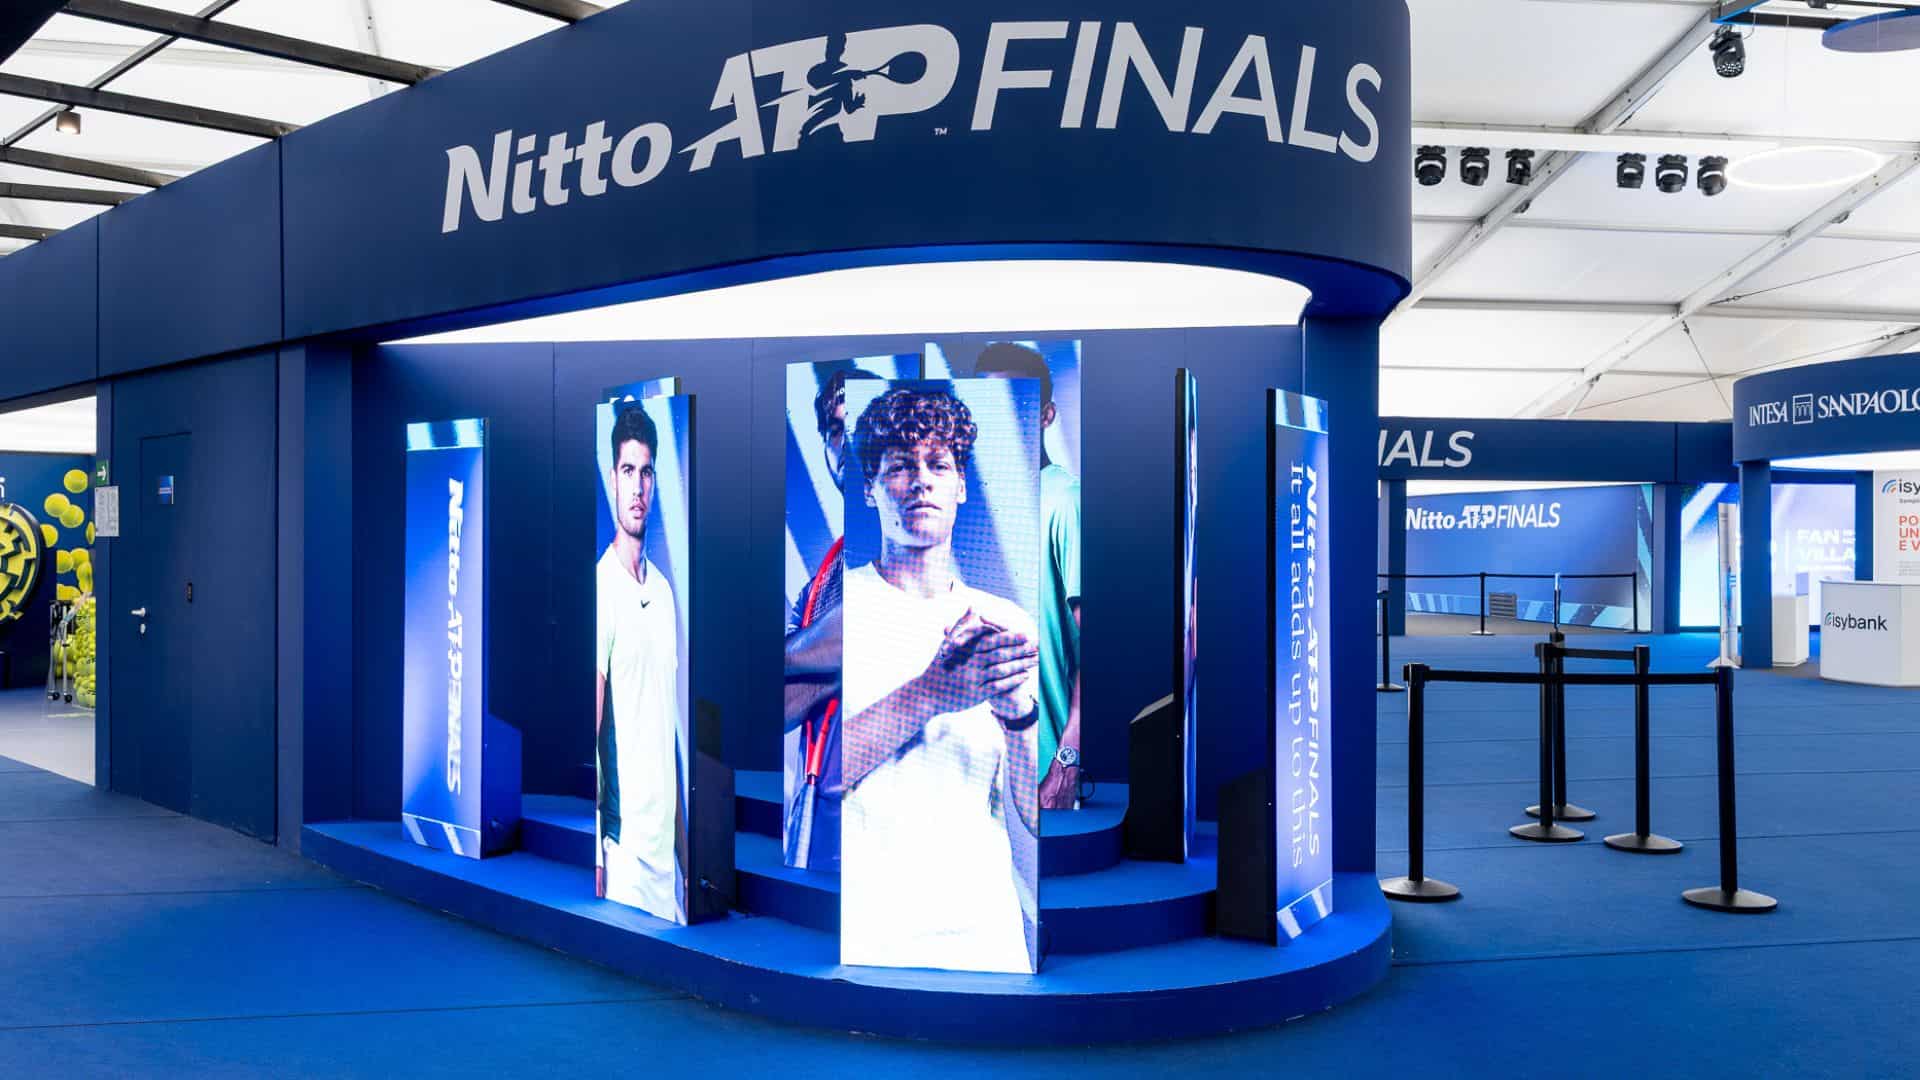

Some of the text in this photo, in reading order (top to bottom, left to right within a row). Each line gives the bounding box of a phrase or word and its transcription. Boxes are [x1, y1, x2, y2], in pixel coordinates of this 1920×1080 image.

[441, 121, 672, 233] Nitto
[679, 24, 961, 172] ATP
[970, 20, 1382, 163] FINALS
[1748, 401, 1789, 427] INTESA
[1306, 466, 1317, 609] Nitto
[1406, 502, 1561, 530] Nitto ATP FINALS
[1797, 529, 1839, 545] FAN
[1832, 613, 1888, 632] isybank
[1289, 463, 1305, 868] It all adds up to this
[1308, 716, 1321, 856] FINALS
